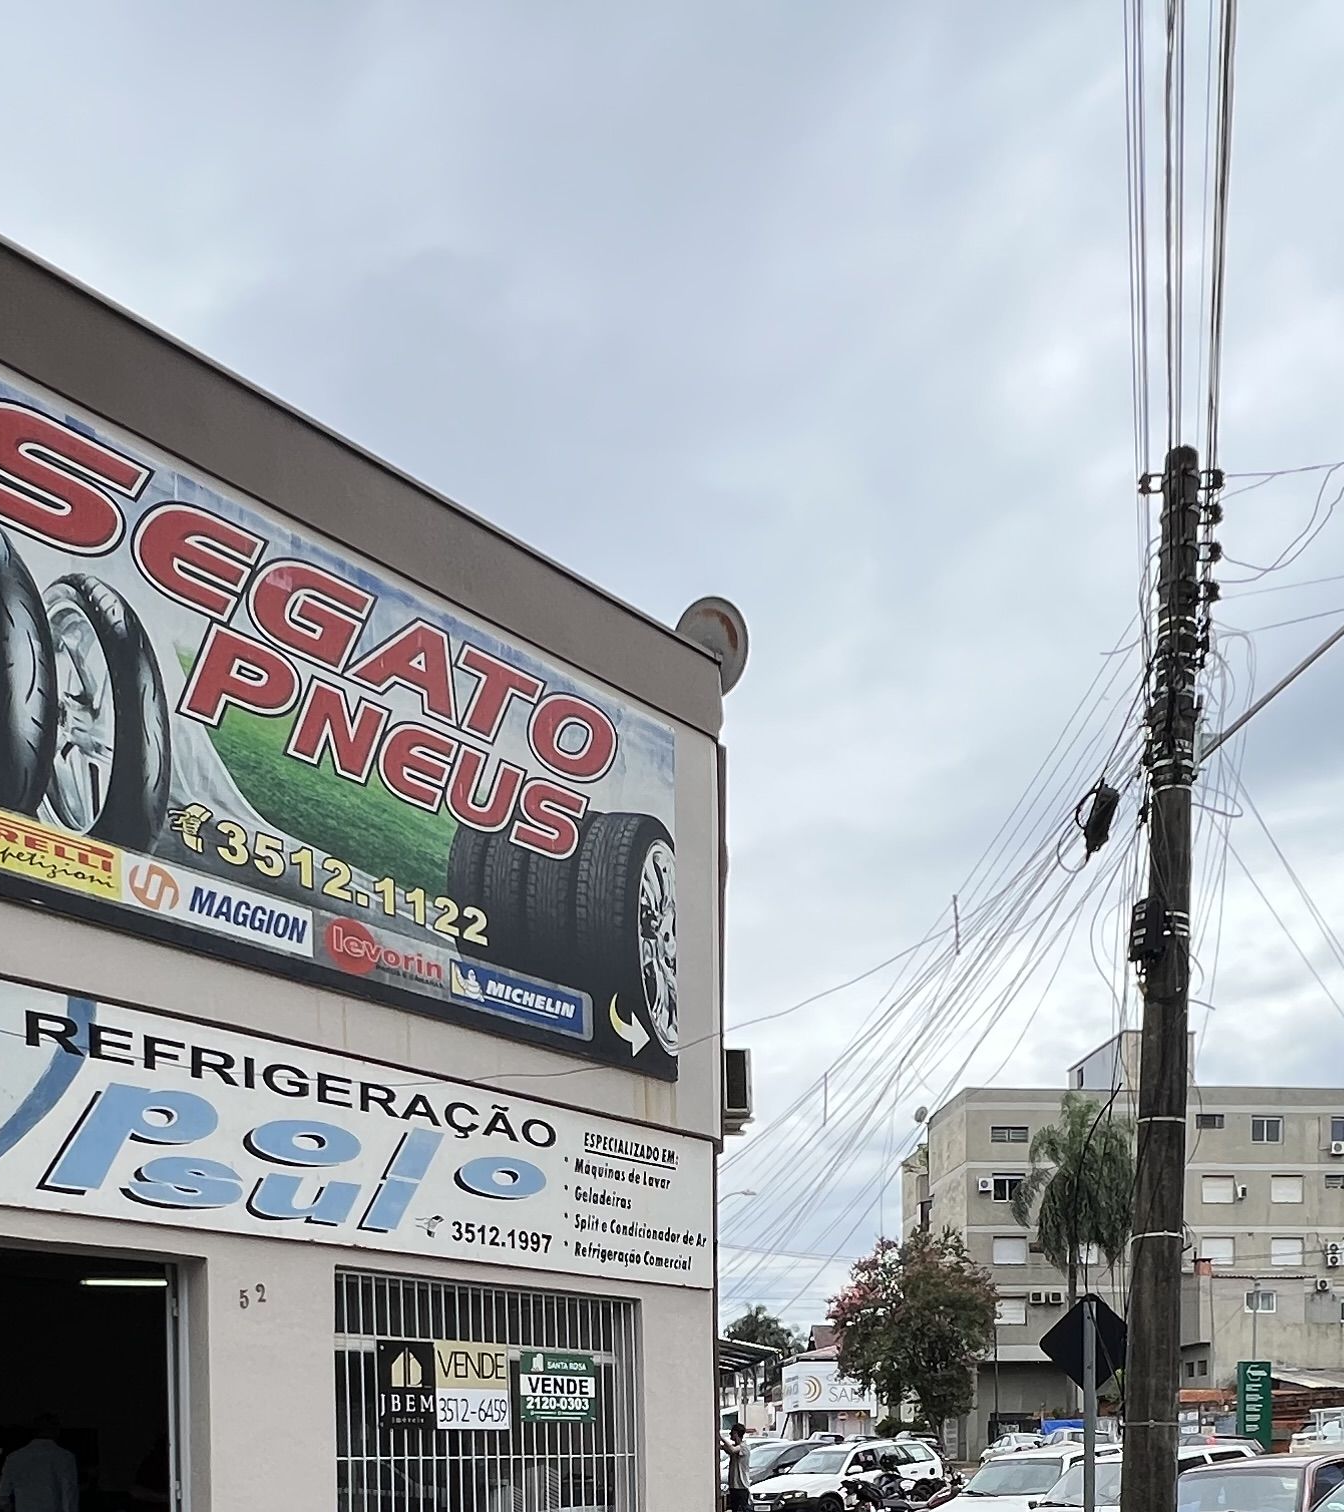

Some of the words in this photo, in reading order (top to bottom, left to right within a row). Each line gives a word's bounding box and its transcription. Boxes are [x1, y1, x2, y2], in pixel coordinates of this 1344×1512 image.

[176, 620, 592, 861] PNEUS
[216, 821, 488, 947] 3512.1122
[188, 886, 308, 944] MAGGION
[332, 926, 443, 981] levorin
[485, 979, 575, 1019] MICHELIN
[24, 1009, 558, 1149] REFRIGERAÇÃO
[584, 1132, 659, 1162] ESPECIALIZADO
[661, 1149, 679, 1165] EM:
[575, 1157, 626, 1180] Máquinas
[628, 1168, 641, 1184] de
[643, 1171, 671, 1189] Lavar
[575, 1186, 632, 1209] Geladeiras
[451, 1221, 553, 1255] 3512.1997
[574, 1213, 599, 1232] Split
[601, 1221, 608, 1233] e
[610, 1219, 681, 1244] Condicionador
[683, 1229, 694, 1246] de
[696, 1232, 707, 1248] Ar
[574, 1241, 641, 1267] Refrigeração
[643, 1250, 692, 1271] Comercial
[436, 1350, 506, 1379] VENDE
[547, 1361, 569, 1370] SANTA
[527, 1376, 589, 1395] VENDE
[438, 1397, 507, 1423] 3512-6459
[525, 1396, 590, 1410] 2120-0303
